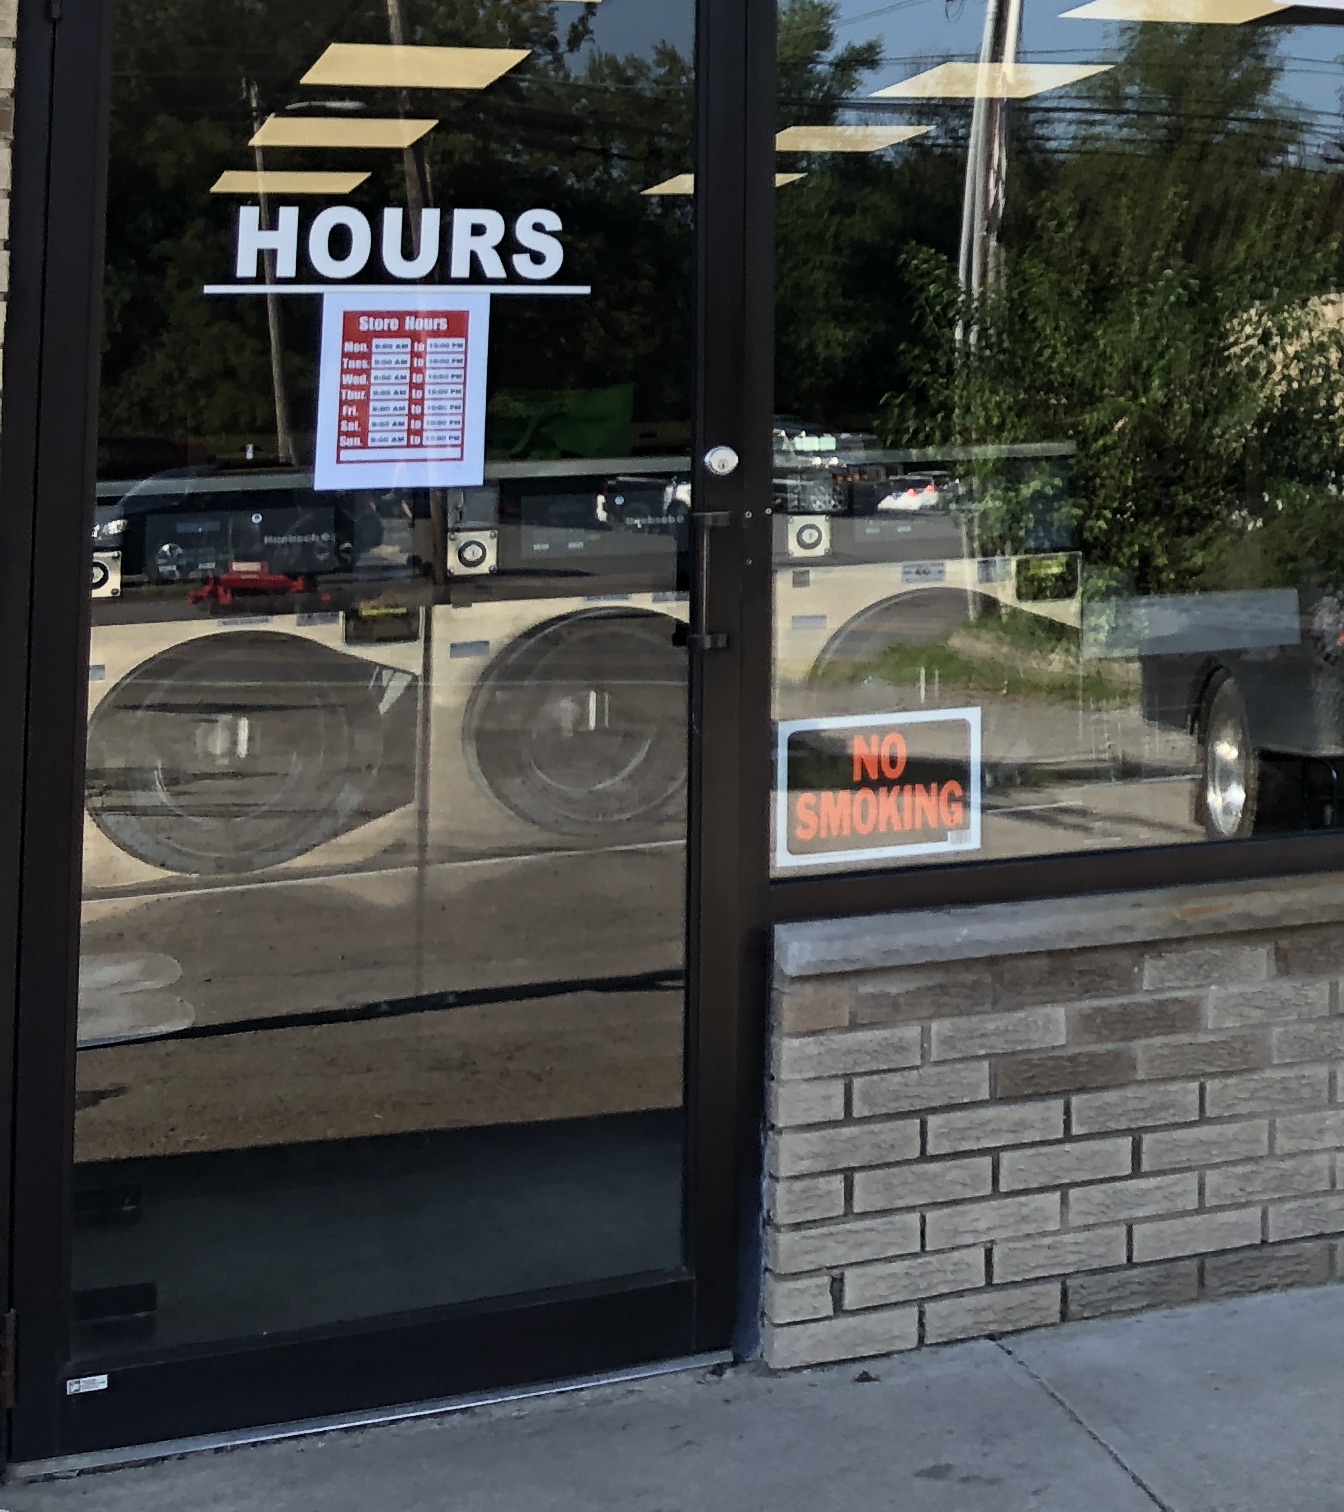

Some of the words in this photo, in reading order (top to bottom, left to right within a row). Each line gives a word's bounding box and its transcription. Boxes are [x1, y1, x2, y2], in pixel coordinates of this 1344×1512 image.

[235, 205, 564, 280] HOURS
[359, 315, 399, 331] Store
[405, 315, 448, 331] Hours
[852, 732, 907, 782] NO
[794, 779, 964, 841] SMOKING
